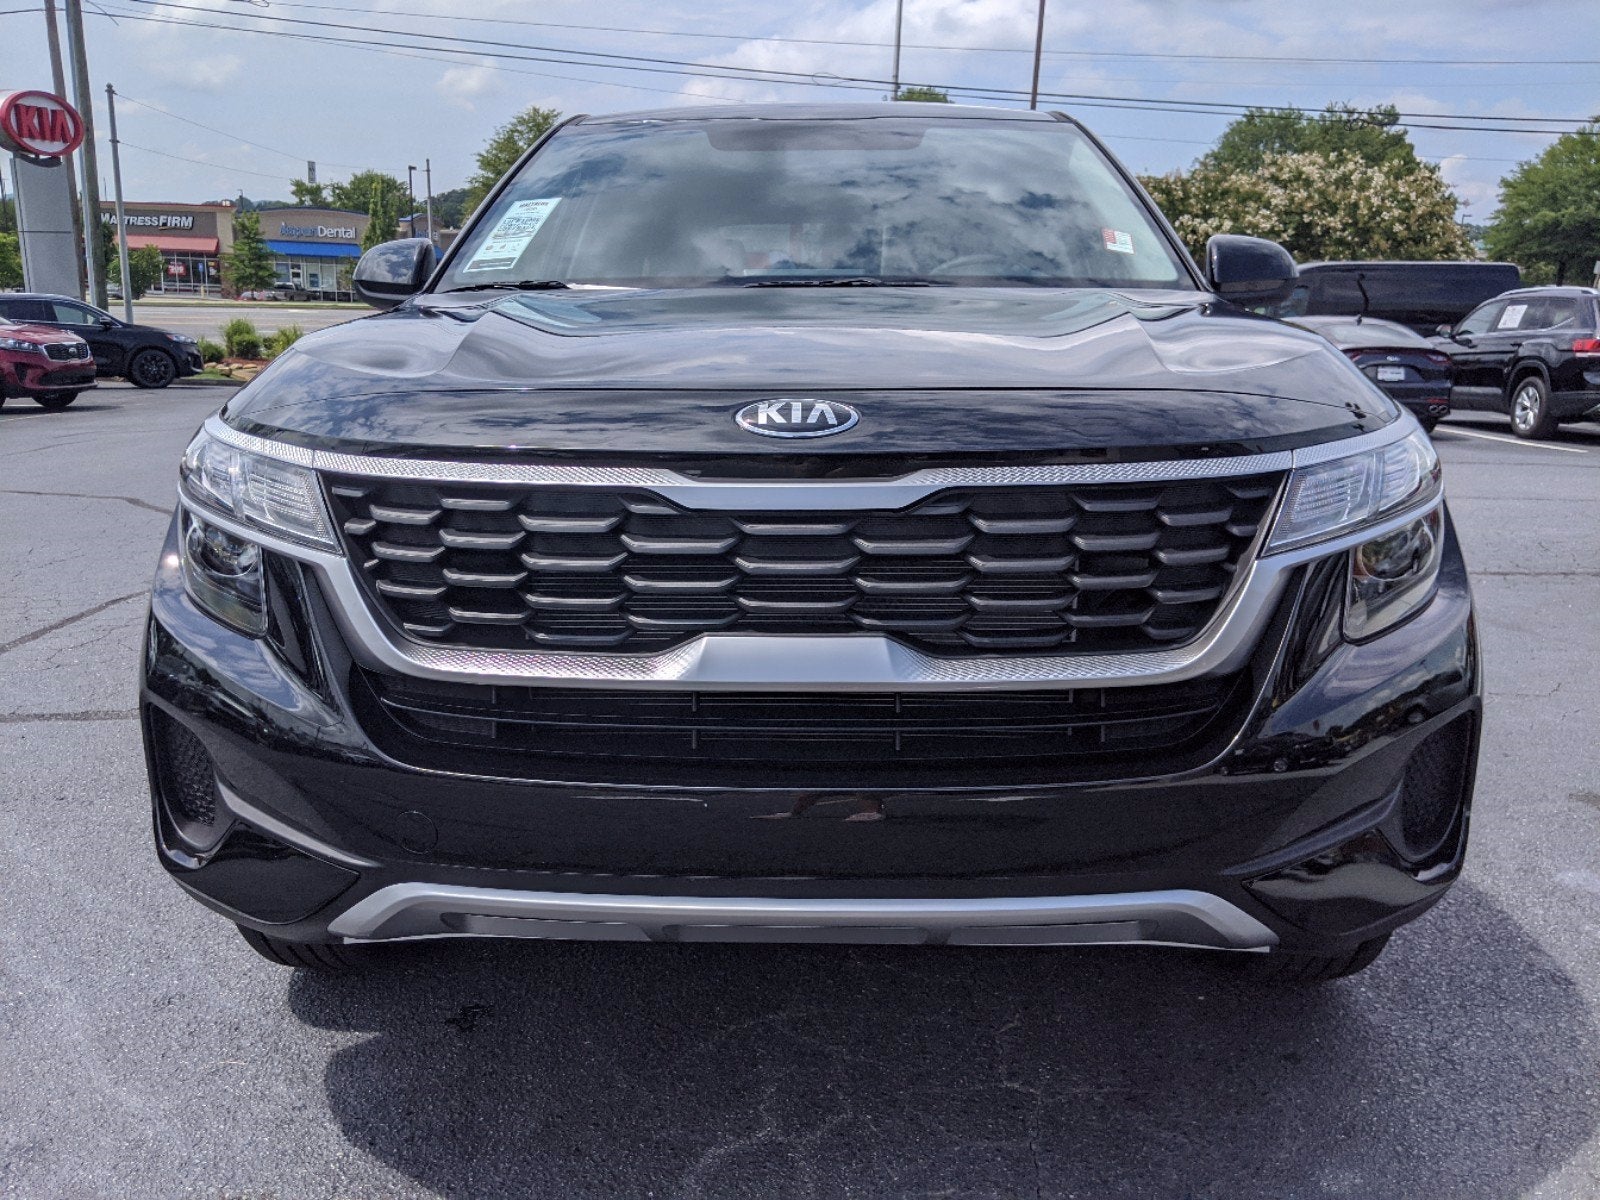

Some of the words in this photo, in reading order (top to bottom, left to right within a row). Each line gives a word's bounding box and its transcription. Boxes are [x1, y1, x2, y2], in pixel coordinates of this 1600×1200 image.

[13, 104, 73, 143] KIA
[101, 213, 158, 226] MATRESS
[159, 215, 192, 227] FIRM
[318, 225, 355, 238] Dental
[757, 401, 838, 425] KIA
